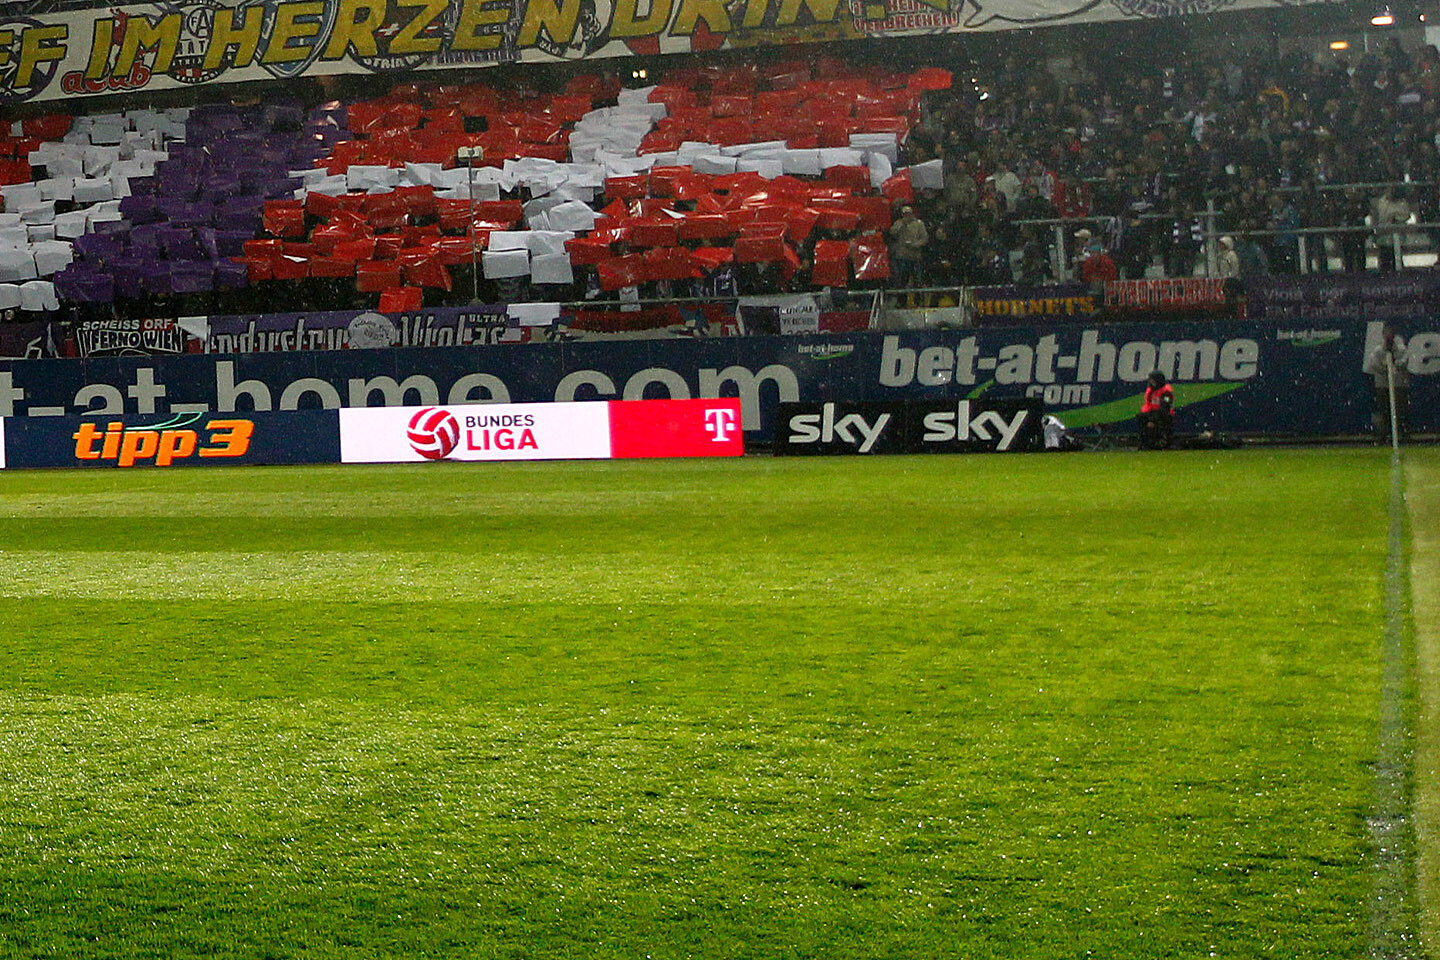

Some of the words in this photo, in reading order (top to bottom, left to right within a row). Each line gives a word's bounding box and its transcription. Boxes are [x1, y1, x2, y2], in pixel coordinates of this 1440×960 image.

[84, 11, 183, 80] IM
[82, 319, 140, 331] SCHEISS
[144, 318, 174, 330] ORF
[879, 329, 1259, 387] bet-at-home
[1026, 382, 1092, 404] com
[466, 415, 534, 428] BUNDES
[789, 403, 890, 453] sky
[924, 400, 1028, 451] sky
[467, 429, 539, 451] LIGA
